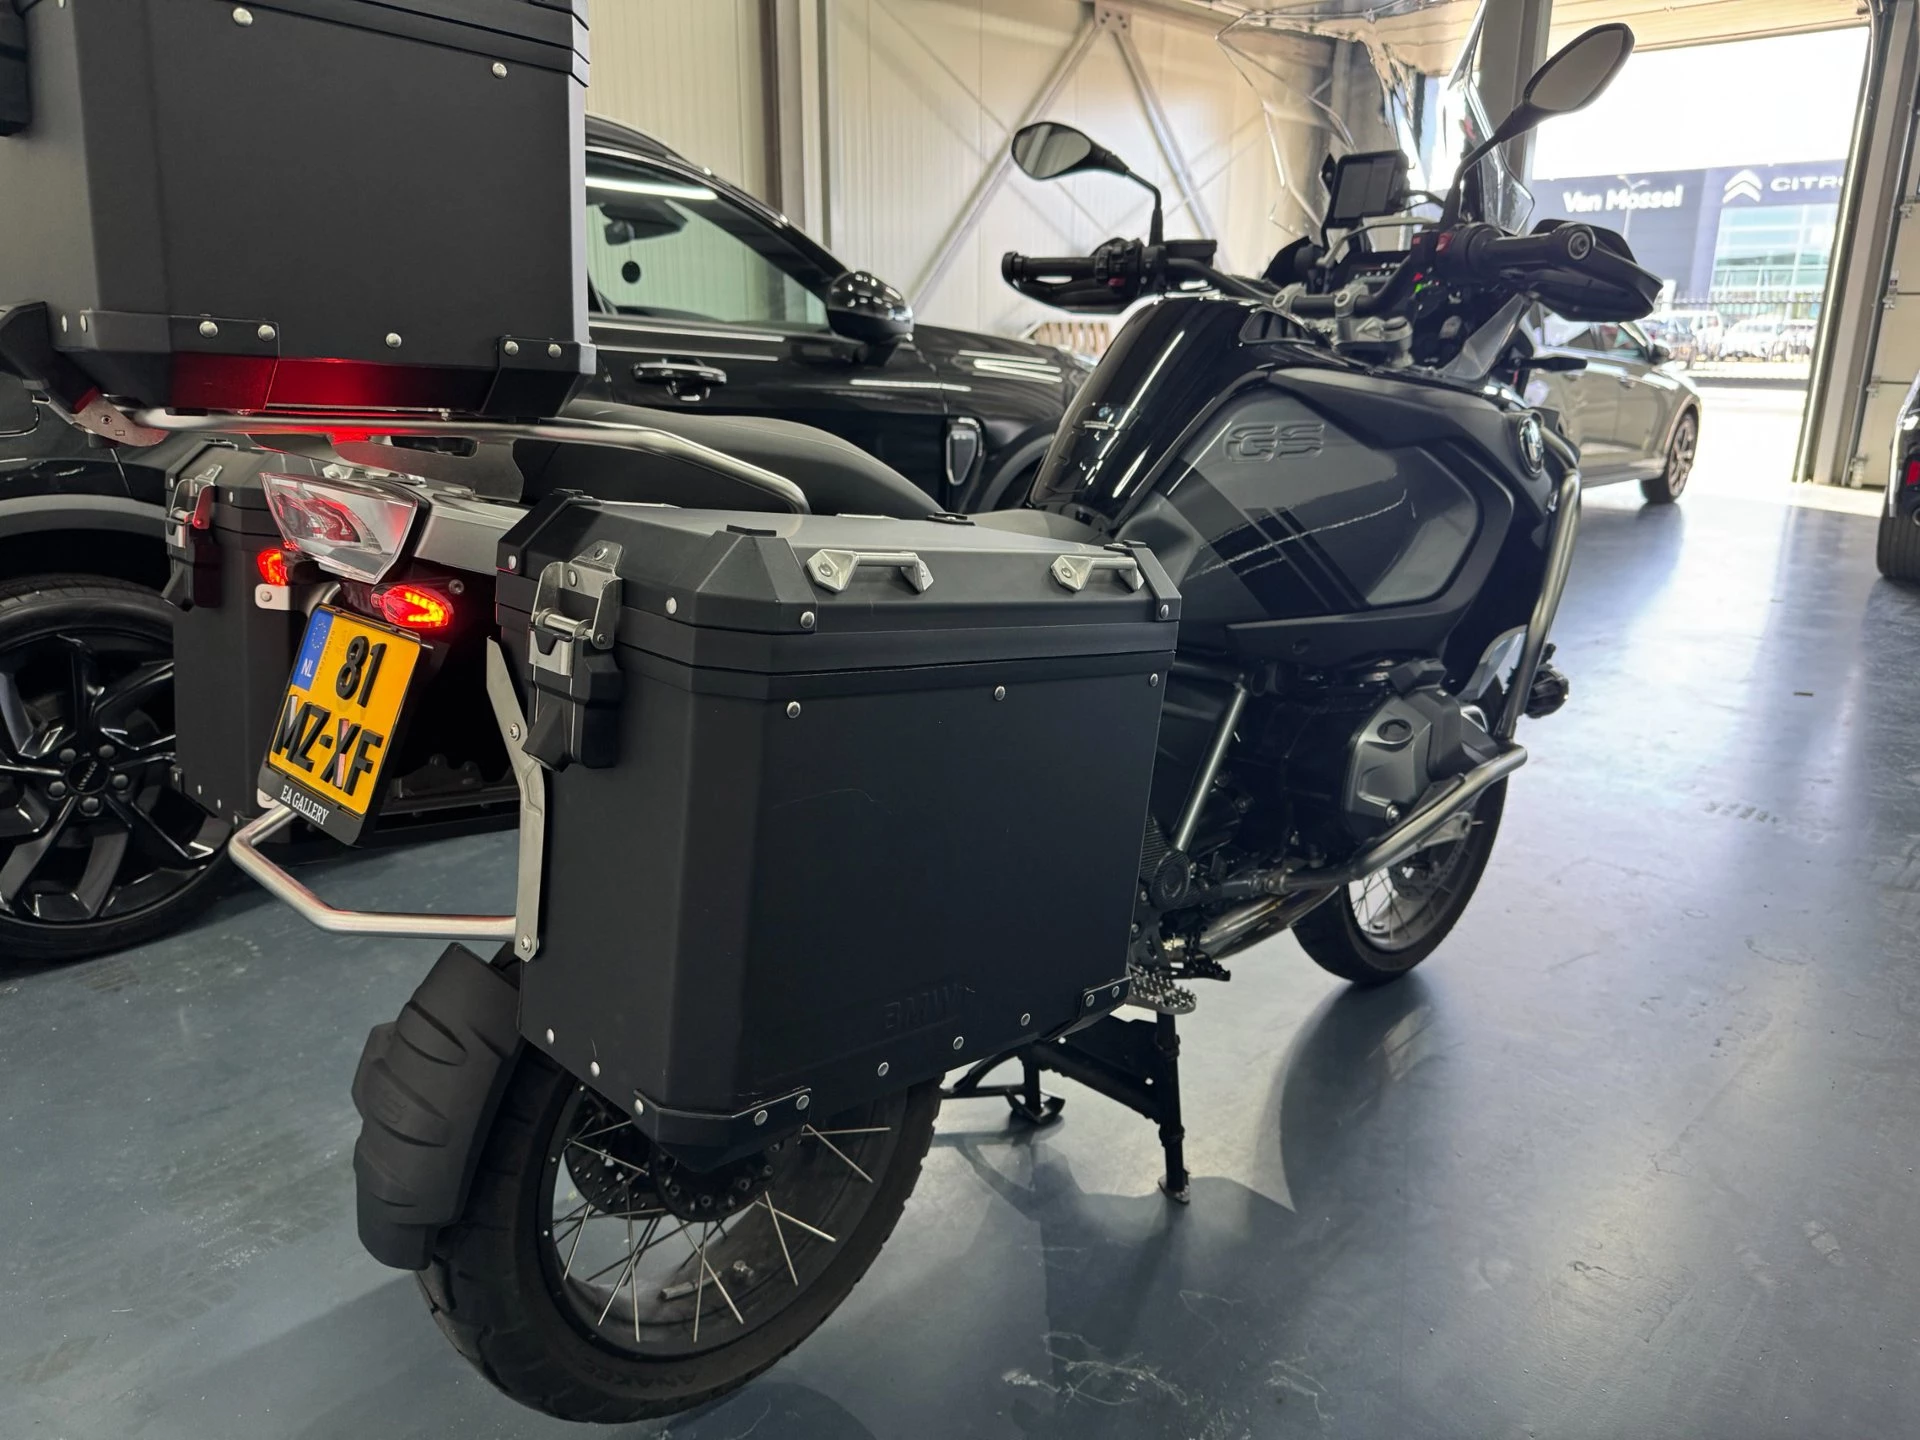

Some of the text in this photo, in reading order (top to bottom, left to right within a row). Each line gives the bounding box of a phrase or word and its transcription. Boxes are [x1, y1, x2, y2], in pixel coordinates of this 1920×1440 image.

[1563, 184, 1684, 212] Van Mossel
[1224, 421, 1326, 463] GS
[301, 658, 312, 678] NL
[335, 635, 387, 708] 81
[272, 694, 384, 797] MZ-XF
[280, 784, 330, 826] EA GALLERY
